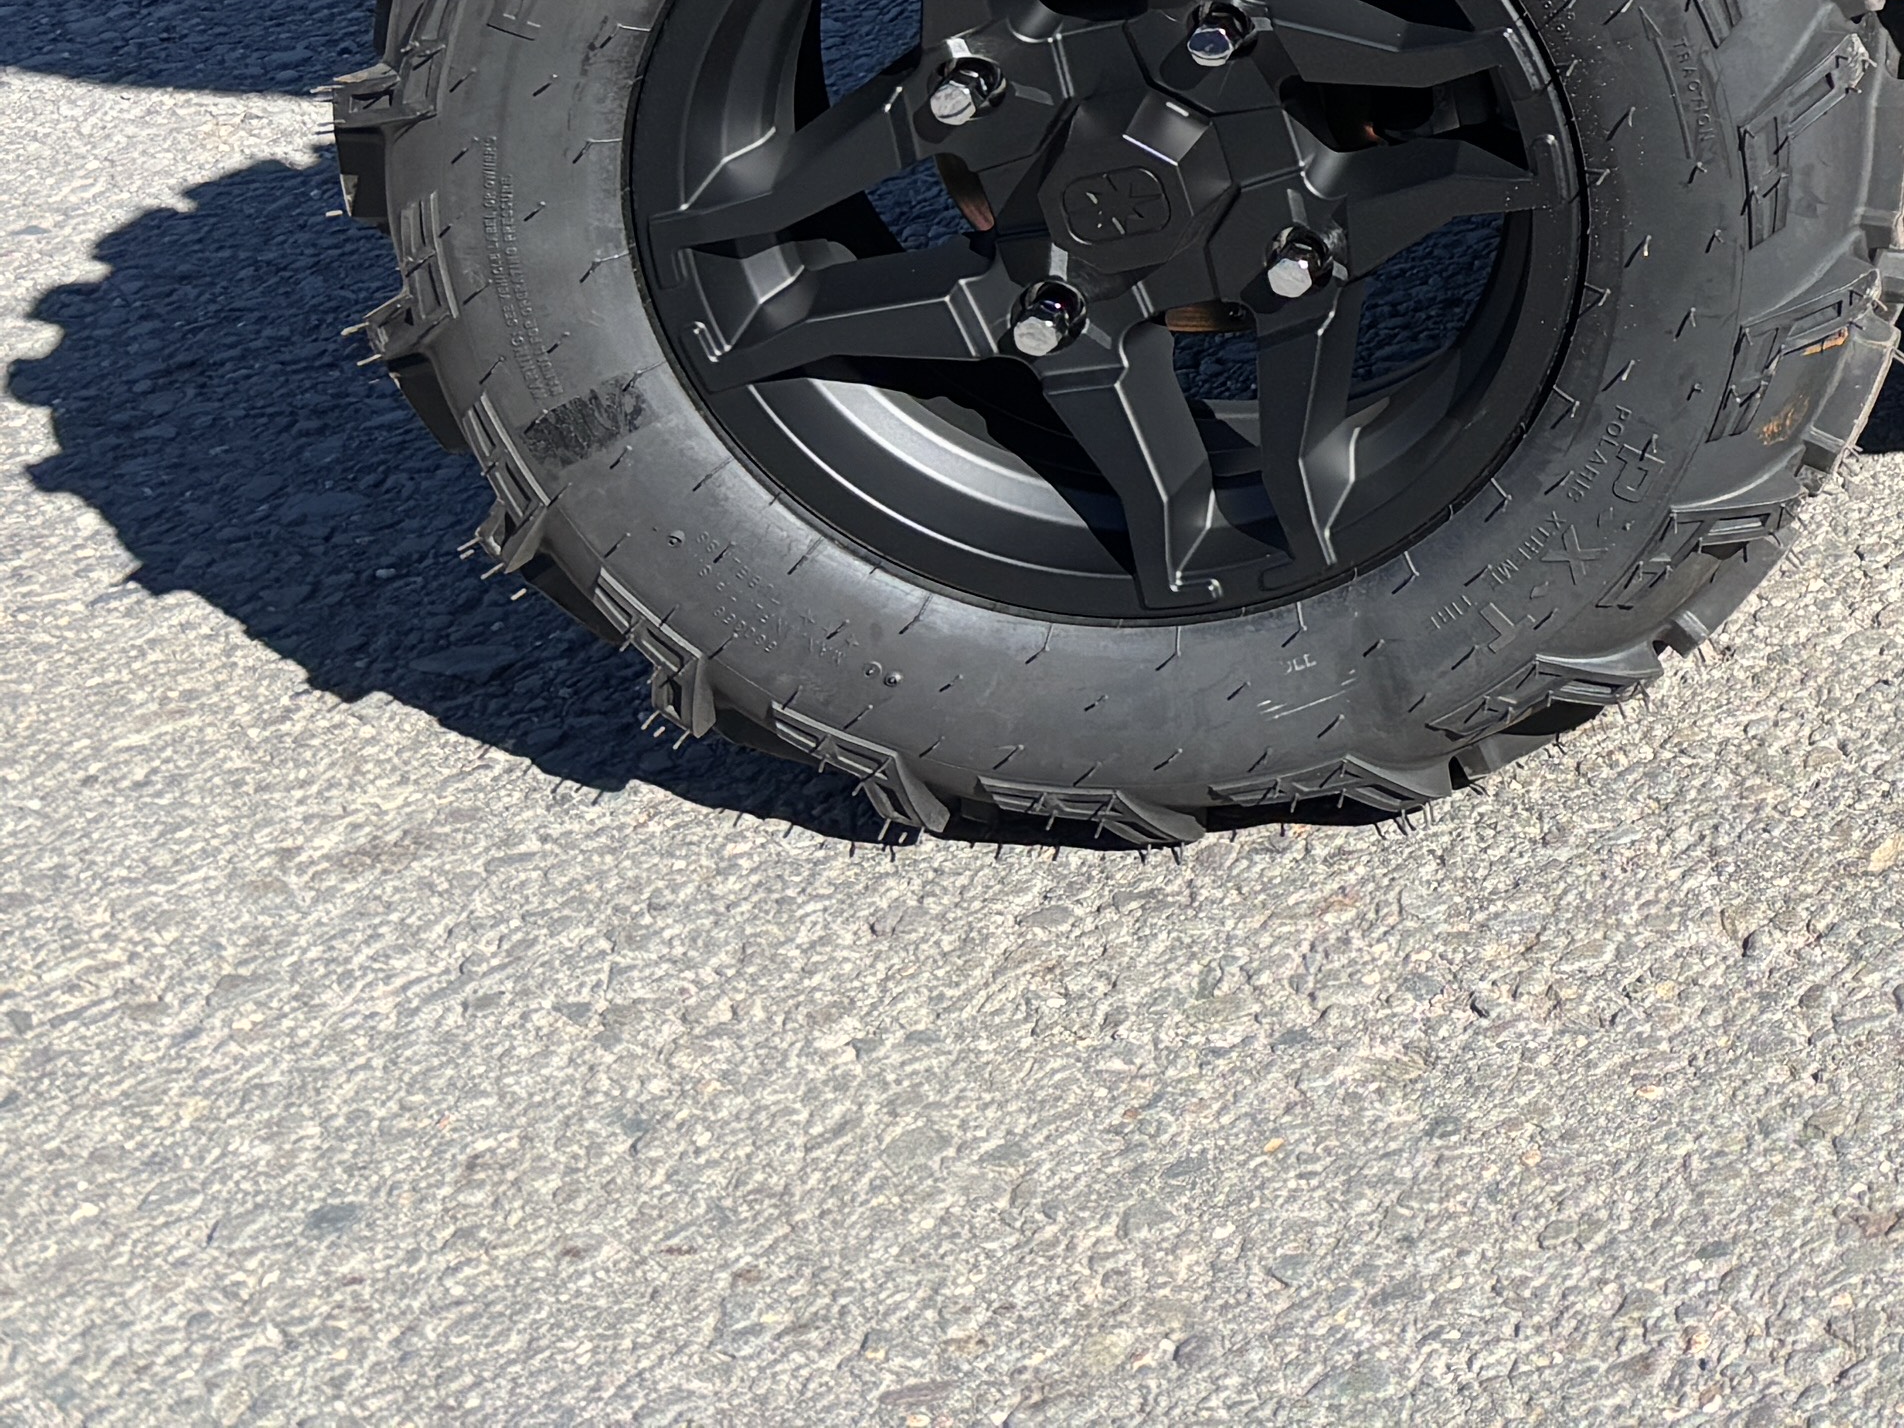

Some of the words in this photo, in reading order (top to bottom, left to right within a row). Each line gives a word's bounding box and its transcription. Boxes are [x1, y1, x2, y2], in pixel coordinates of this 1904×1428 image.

[1670, 36, 1713, 143] TRACTION
[1560, 402, 1634, 505] POLARIS
[1480, 508, 1568, 591] XTREME
[1422, 590, 1477, 633] TIRE
